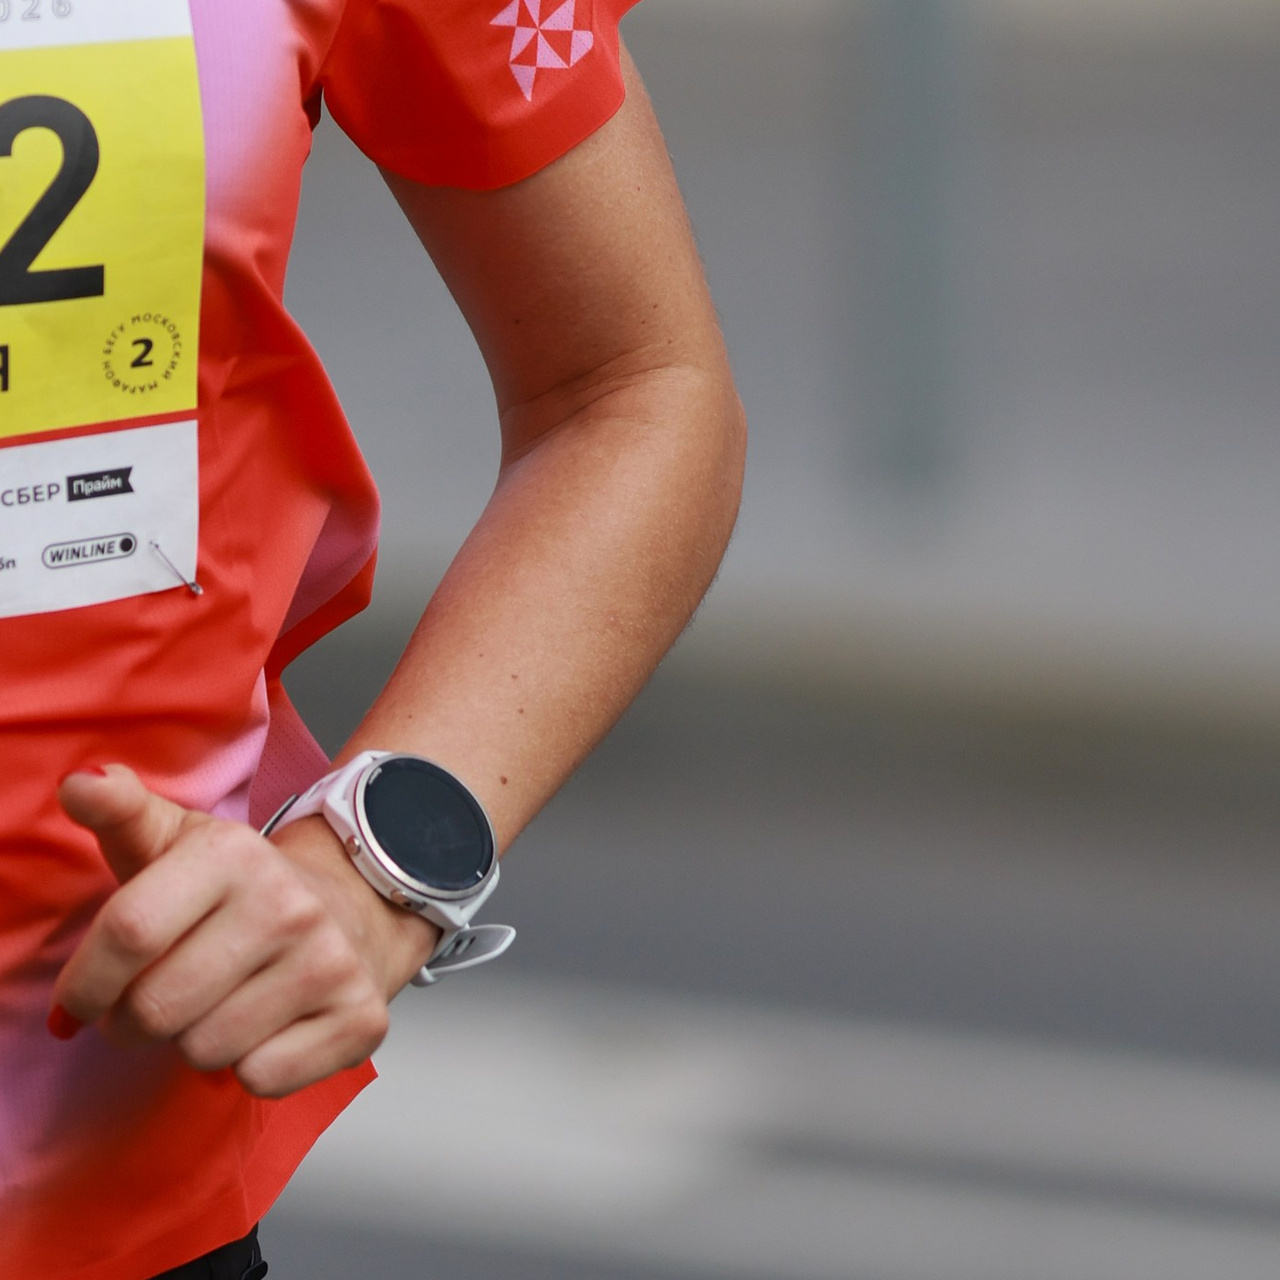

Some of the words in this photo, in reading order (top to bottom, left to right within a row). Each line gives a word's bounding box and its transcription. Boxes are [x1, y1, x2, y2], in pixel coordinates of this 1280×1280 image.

[131, 338, 153, 368] 2
[1, 483, 60, 507] СБЕР
[73, 475, 123, 496] Прайм
[49, 540, 116, 564] WINLINE
